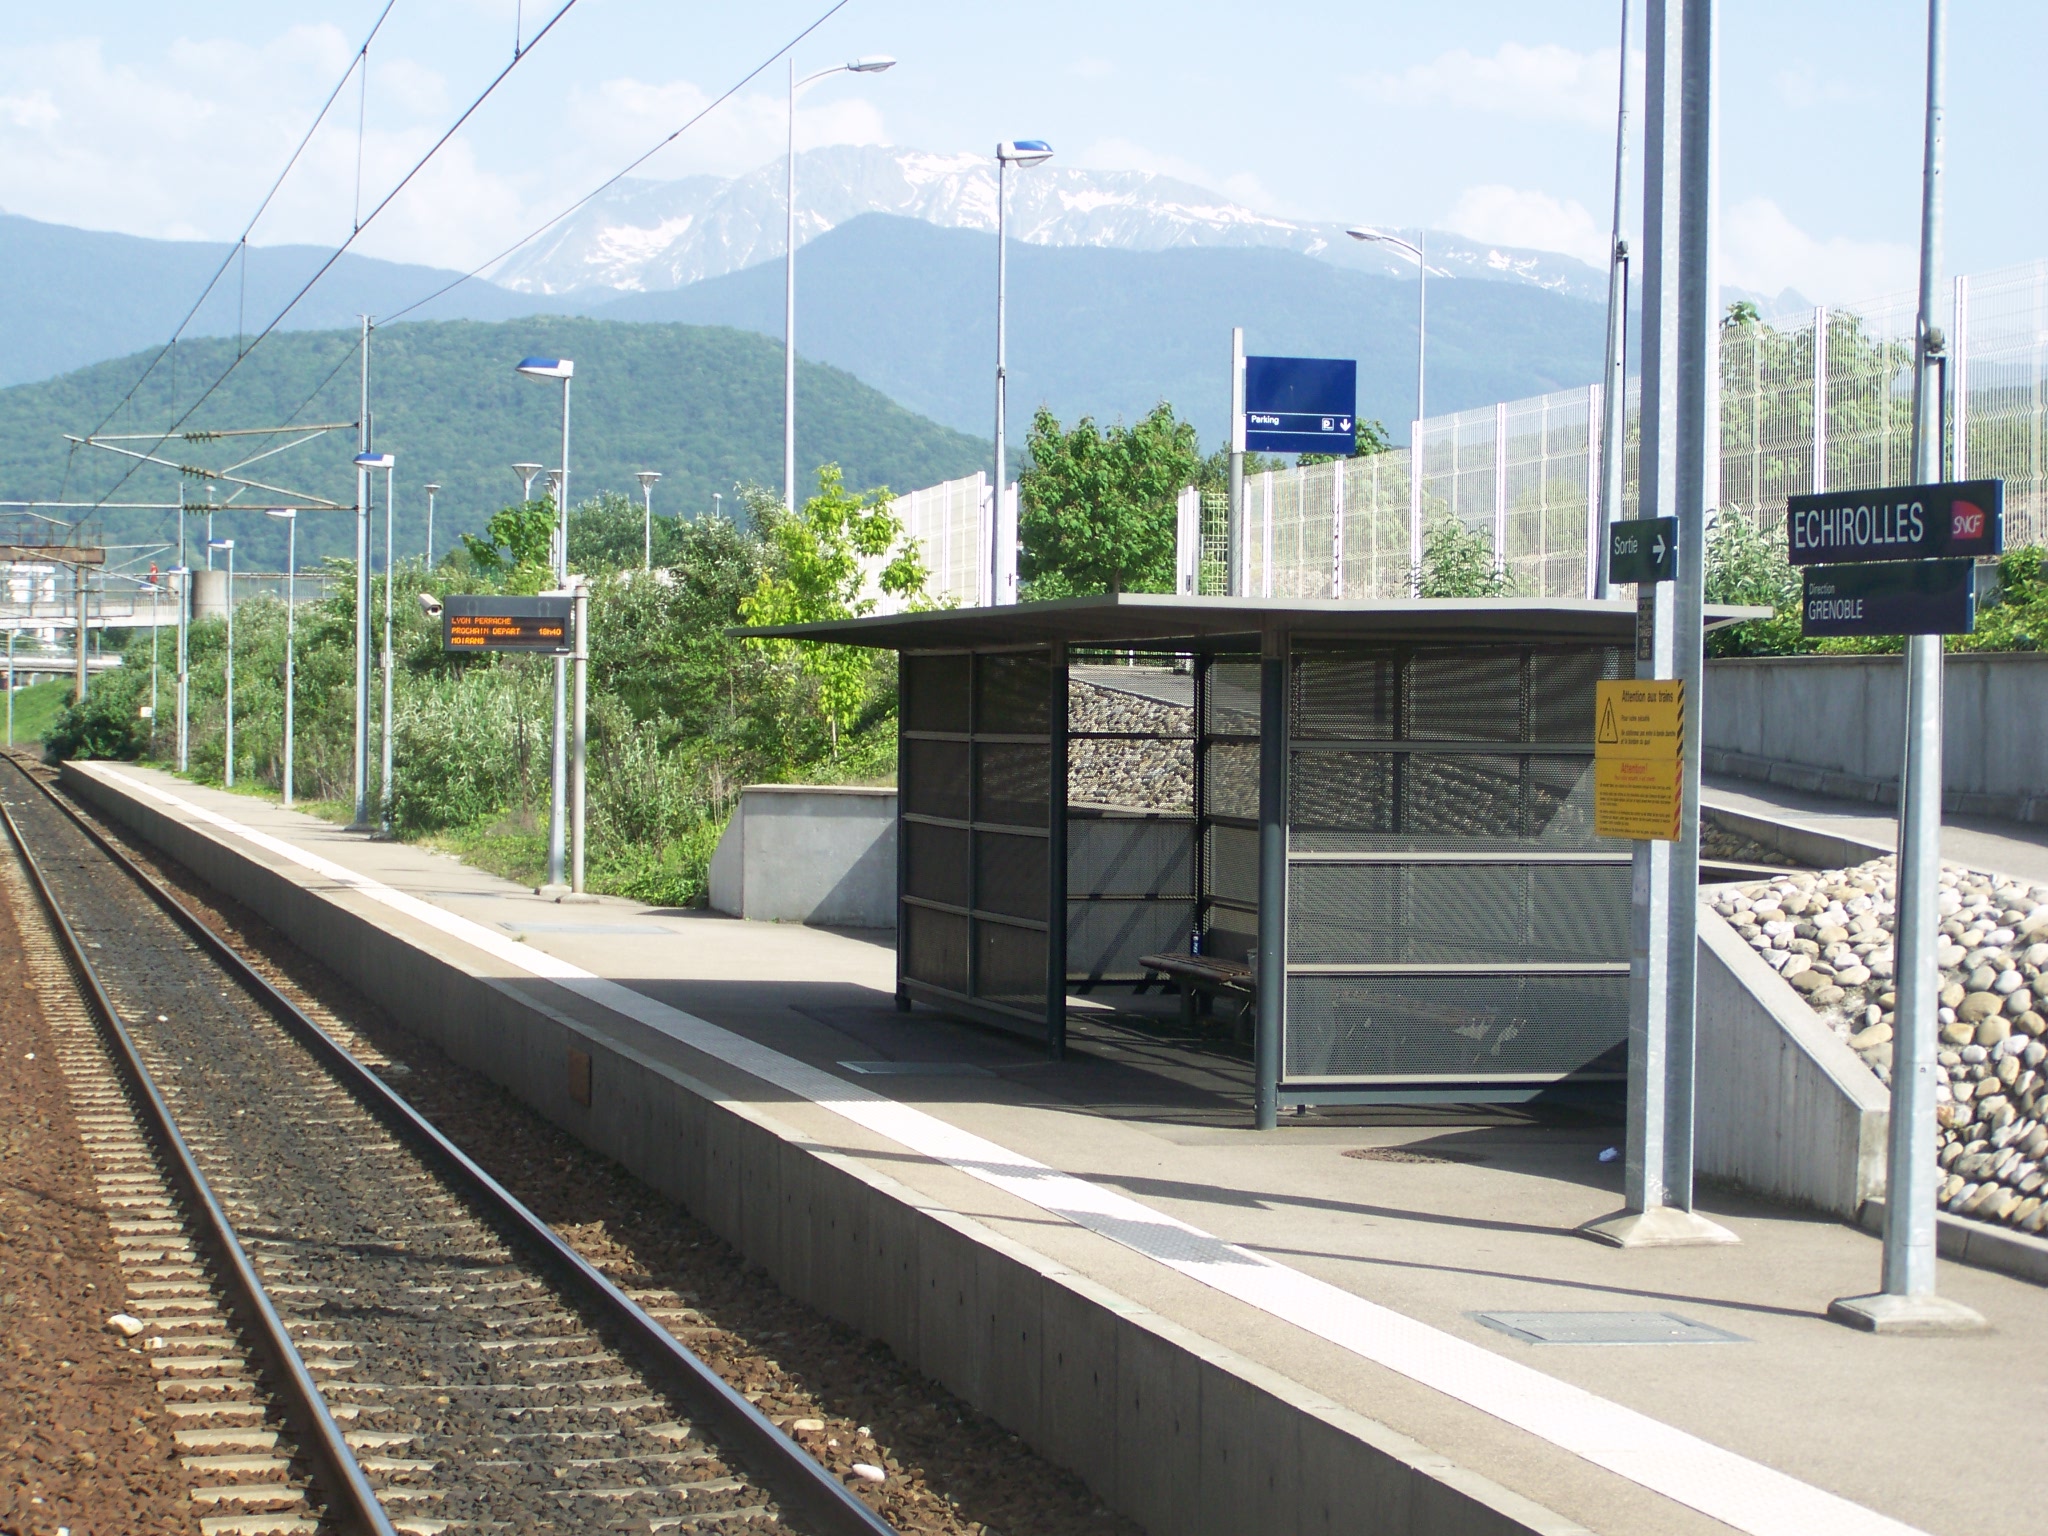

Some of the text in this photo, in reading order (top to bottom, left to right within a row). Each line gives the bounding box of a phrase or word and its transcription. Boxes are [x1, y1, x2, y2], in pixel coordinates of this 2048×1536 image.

[1251, 415, 1279, 425] Parking
[1795, 502, 1923, 548] ECHIROLLES
[1953, 514, 1982, 535] SNCF
[1614, 535, 1638, 555] Sortie
[1809, 583, 1835, 595] Direction
[1808, 599, 1863, 620] GRENOBLE
[451, 617, 512, 625] LYON PERRACHE
[451, 627, 489, 635] PROCHAIN
[451, 637, 485, 645] MOIRANS
[1622, 690, 1673, 702] Attention aux trains
